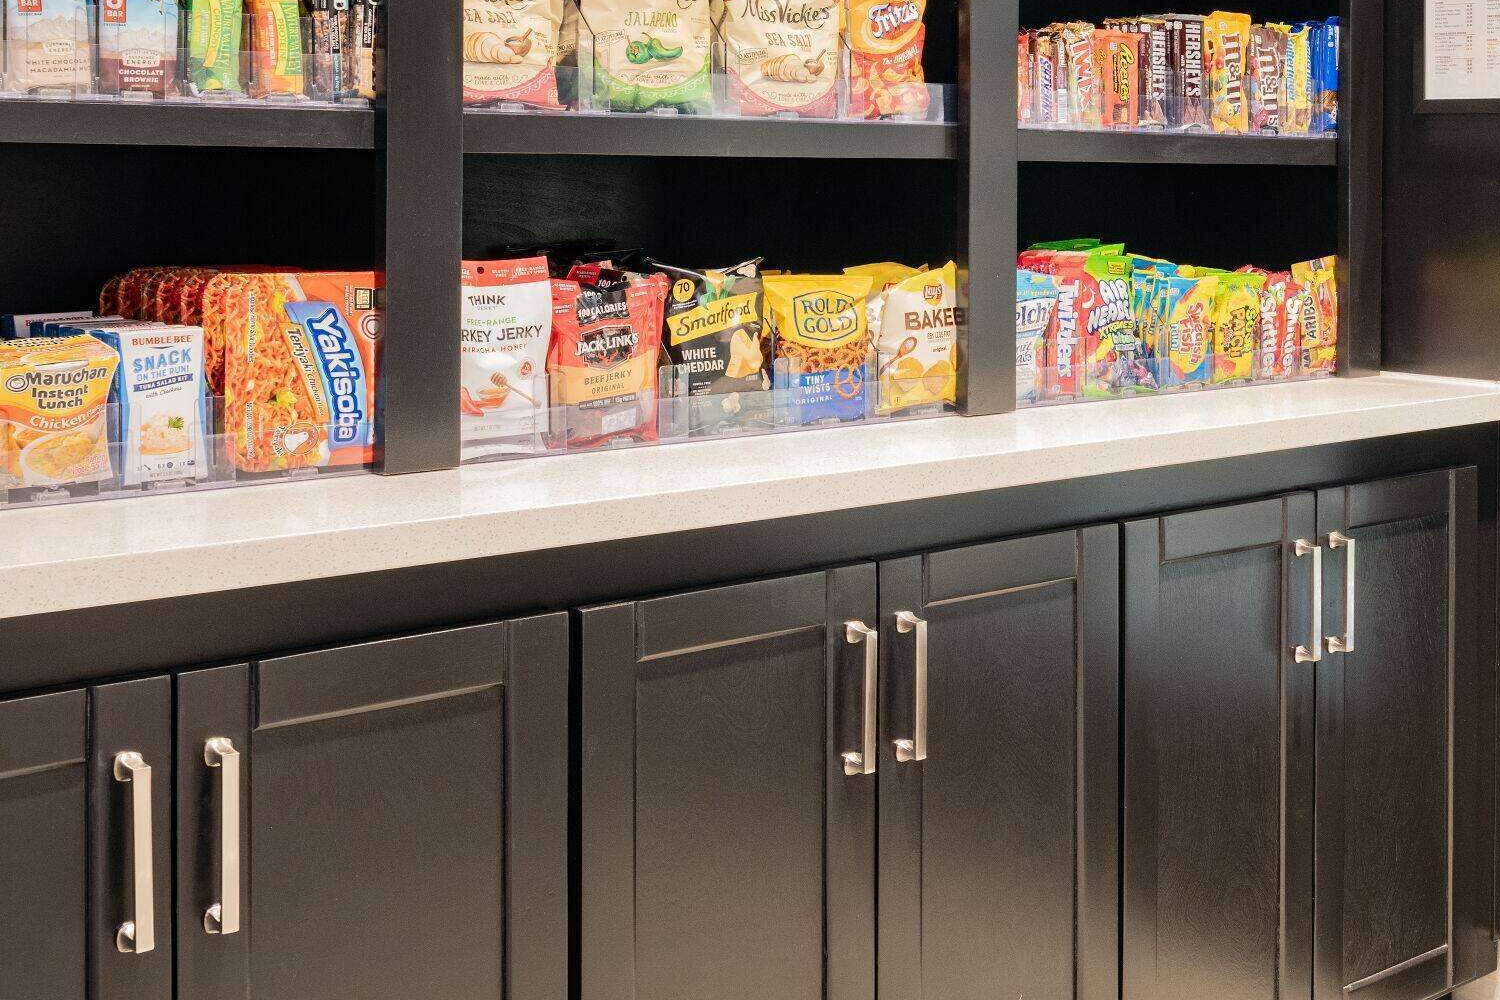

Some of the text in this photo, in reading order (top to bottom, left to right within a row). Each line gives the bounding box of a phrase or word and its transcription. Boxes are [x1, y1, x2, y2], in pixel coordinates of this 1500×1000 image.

[20, 0, 39, 8] BAR
[868, 0, 920, 38] Fritos
[765, 32, 813, 47] SEA SALT
[118, 69, 164, 77] CHOCOLATE
[123, 76, 160, 84] BROWNIE
[1040, 58, 1053, 120] SNICKERS
[677, 282, 690, 294] 70
[923, 284, 943, 300] Lay's
[1100, 278, 1129, 301] AIR
[468, 295, 507, 306] THINK
[801, 298, 849, 315] ROLD
[578, 303, 628, 318] 100 CALORIES
[675, 299, 751, 337] Smartfood
[466, 316, 518, 326] FREE-RANGE
[803, 316, 852, 334] GOLD
[131, 334, 193, 346] BUMBLE BEE
[461, 325, 543, 343] RKEY JERKY
[1179, 318, 1192, 355] Fish
[288, 328, 316, 374] Teriyaki
[500, 344, 528, 353] HONEY
[575, 337, 605, 357] JACK
[681, 347, 717, 360] WHITE
[132, 348, 192, 374] SNACK
[675, 359, 724, 375] CHEDDAR
[26, 366, 108, 387] Maruchan
[136, 368, 167, 382] ON THE
[310, 311, 357, 440] Yakisoba
[585, 369, 633, 386] BEEF JERKY
[805, 374, 826, 386] TINY
[31, 385, 89, 399] Instant
[591, 383, 626, 395] ORIGINAL
[799, 382, 831, 395] TWISTS
[37, 397, 84, 410] Lunch
[795, 395, 833, 406] ORIGINAL
[29, 413, 86, 429] Chicken
